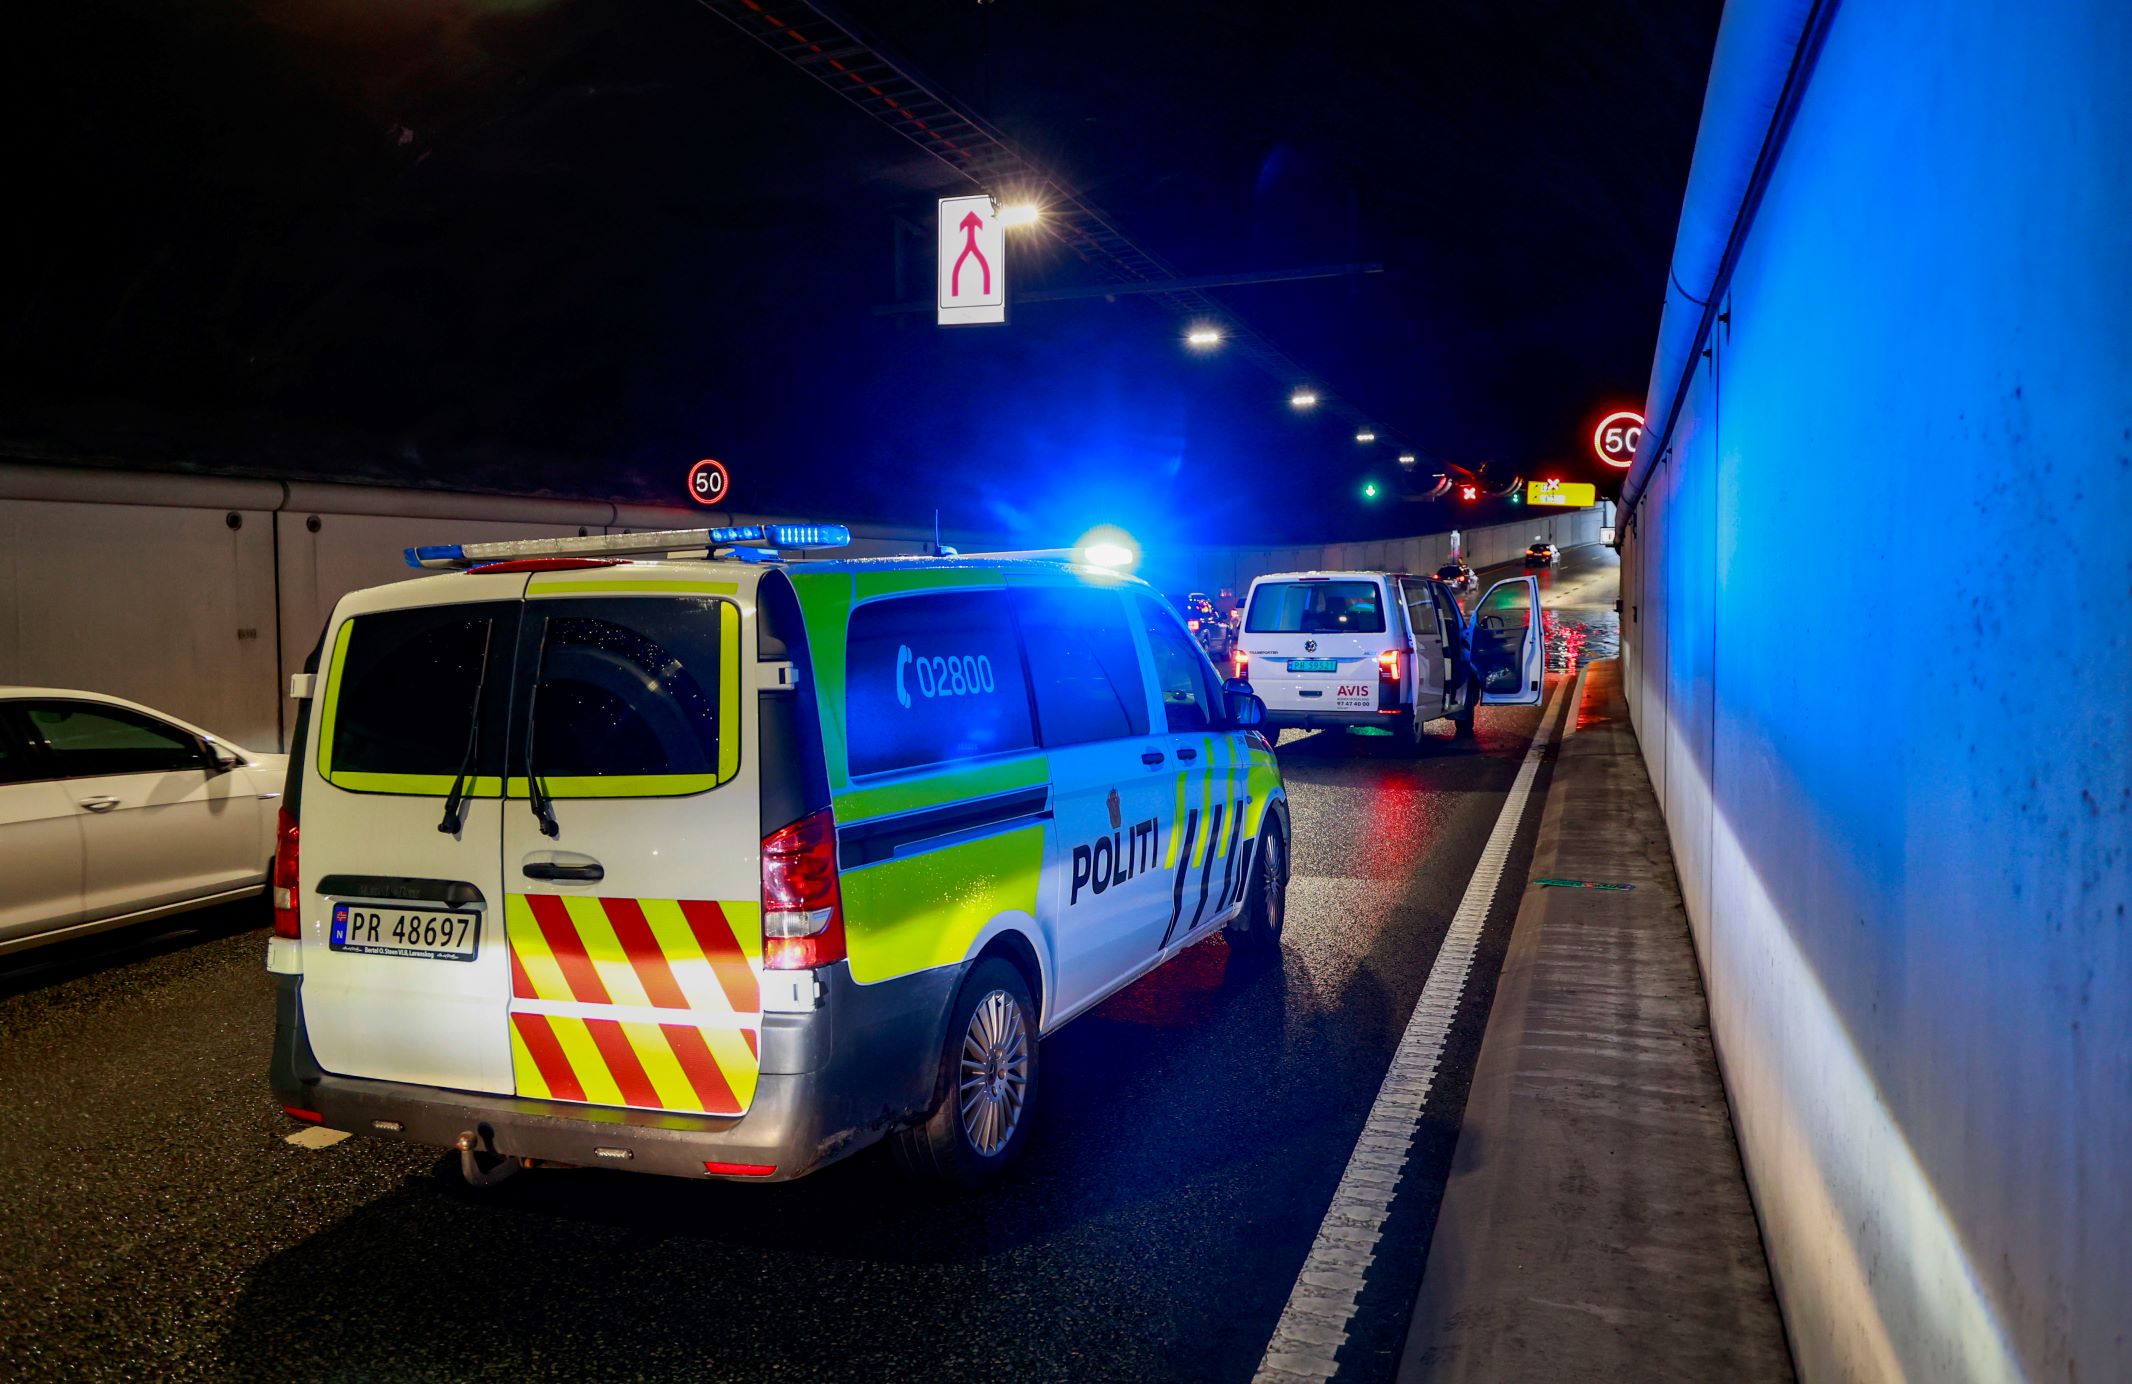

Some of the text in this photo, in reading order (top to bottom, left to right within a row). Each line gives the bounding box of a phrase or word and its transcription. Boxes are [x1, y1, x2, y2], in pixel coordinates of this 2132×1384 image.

[1605, 427, 1642, 453] 50
[696, 472, 721, 492] 50
[916, 655, 994, 698] 02800
[1337, 685, 1369, 696] AVIS
[1070, 816, 1158, 906] POLITI
[336, 930, 344, 939] N
[352, 912, 469, 948] PR 48697
